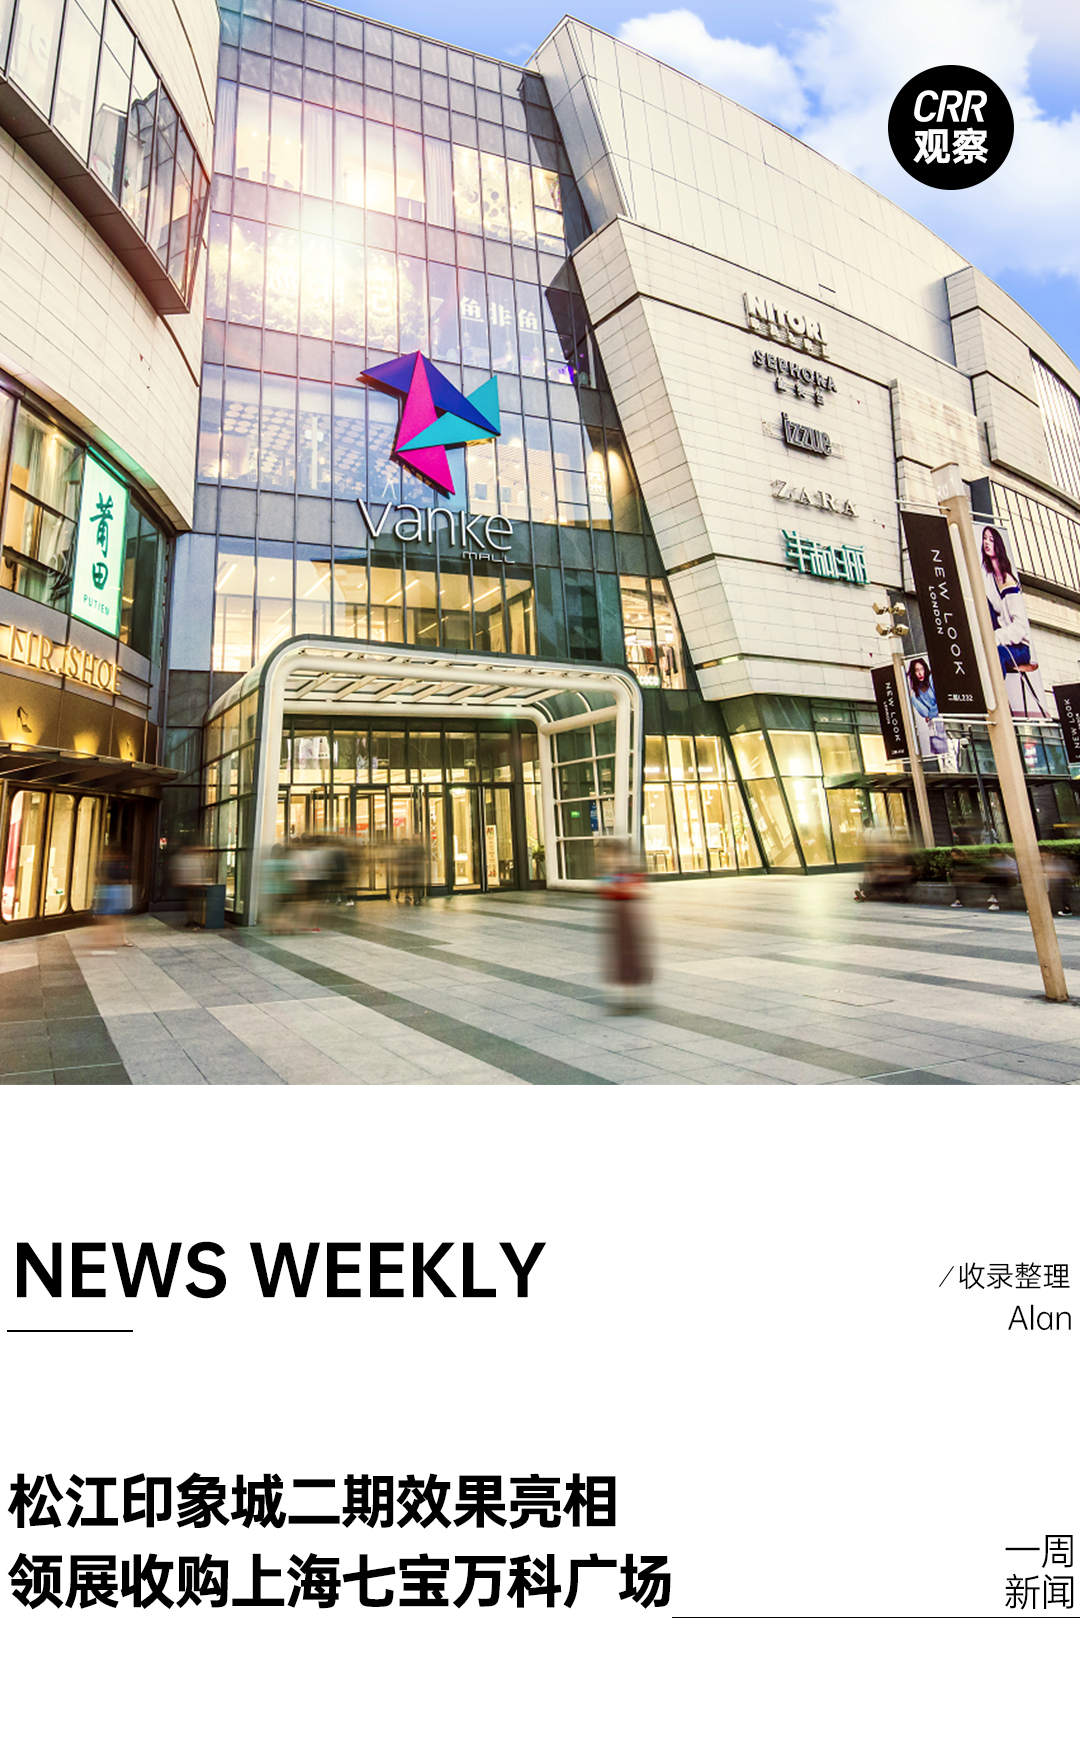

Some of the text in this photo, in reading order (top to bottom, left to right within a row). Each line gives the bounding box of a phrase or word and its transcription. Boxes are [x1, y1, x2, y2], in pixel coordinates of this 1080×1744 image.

[460, 296, 541, 335] 鱼非鱼
[743, 292, 827, 346] NITORI
[753, 350, 837, 392] SEPHORA
[781, 412, 832, 456] izzue
[771, 480, 859, 518] ZARA
[89, 492, 114, 591] 莆田
[462, 551, 515, 563] MALL
[83, 594, 110, 616] PUTIEN
[928, 586, 944, 635] LONDON
[931, 549, 966, 675] NEW LOOK
[885, 682, 894, 706] NEW
[890, 712, 901, 741] LOOK
[1063, 699, 1076, 723] LOOK
